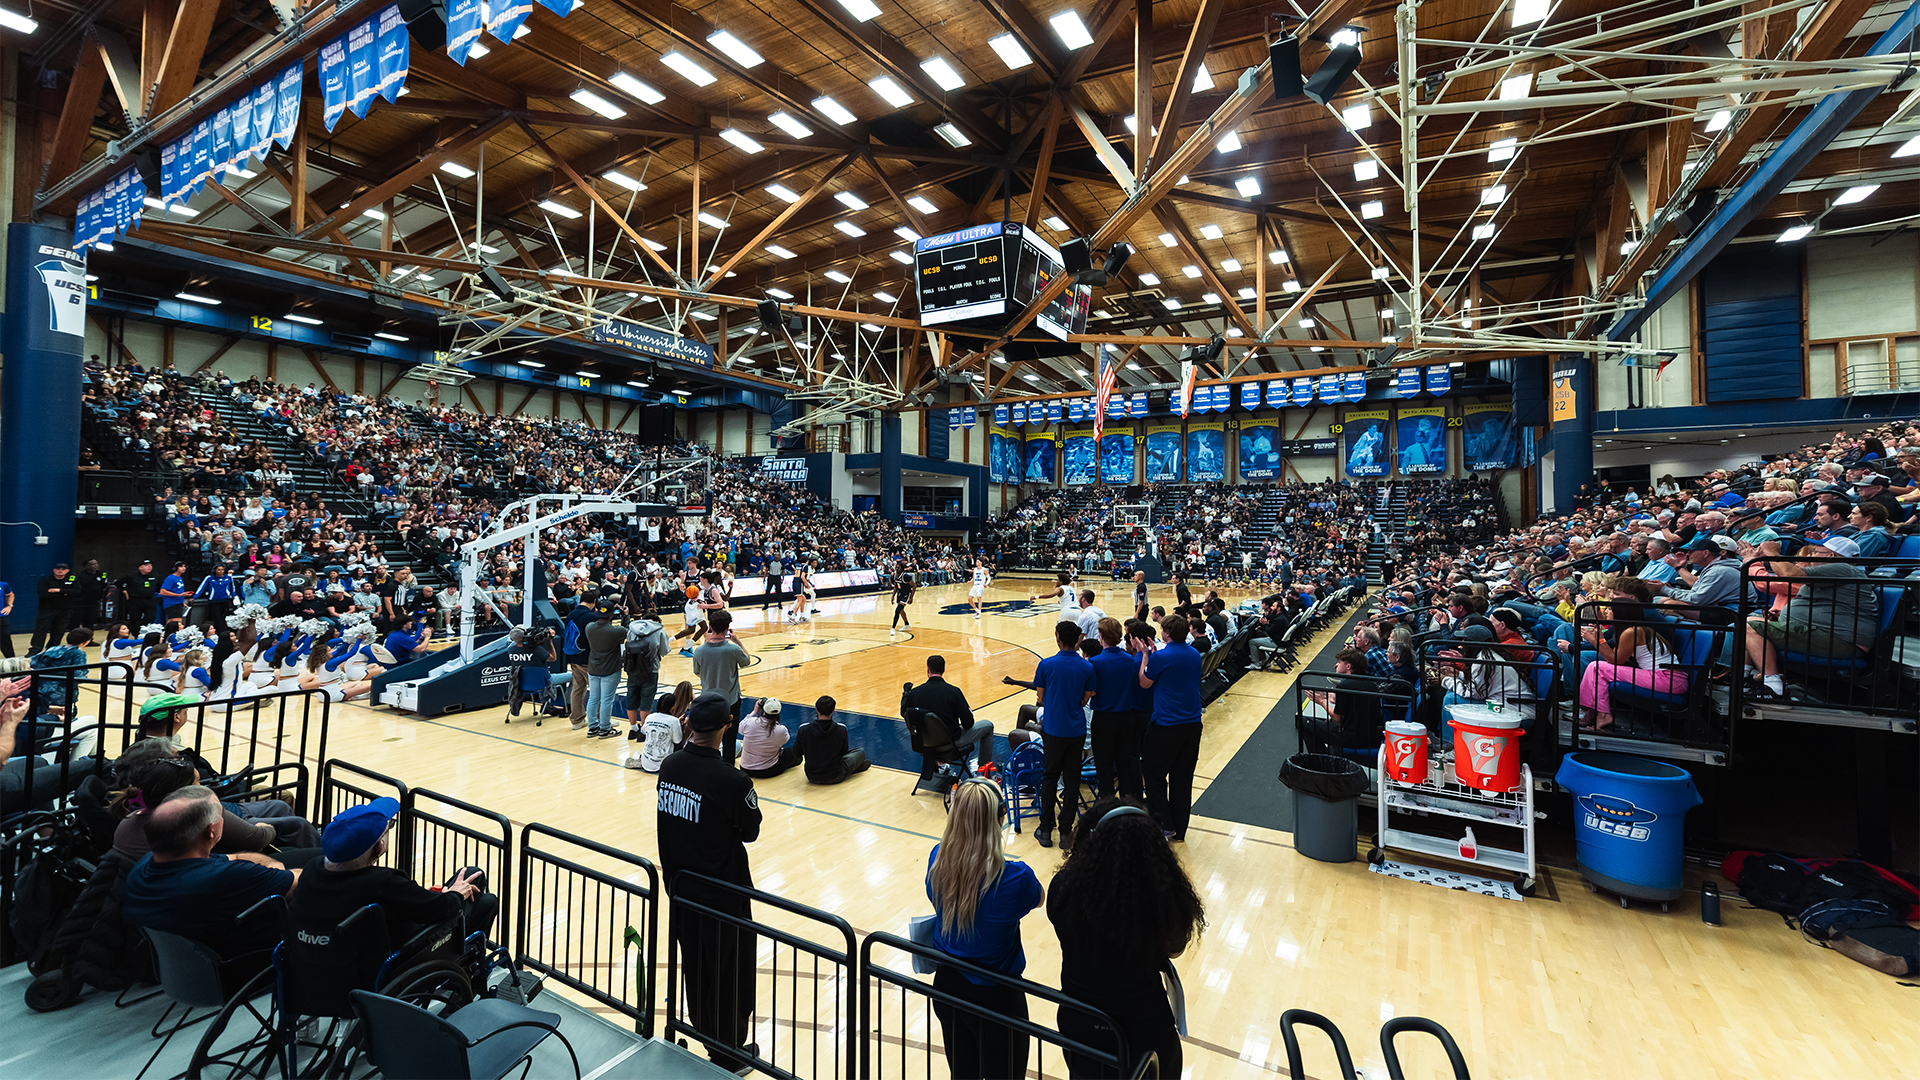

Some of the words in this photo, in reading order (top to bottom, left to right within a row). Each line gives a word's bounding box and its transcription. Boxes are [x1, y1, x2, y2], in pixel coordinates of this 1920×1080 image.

[495, 5, 519, 27] 1992
[924, 234, 955, 249] Michelob
[962, 226, 994, 240] ULTRA
[923, 266, 941, 275] UCSB
[69, 294, 80, 305] 6
[251, 315, 272, 331] 12
[602, 319, 618, 335] The
[620, 324, 676, 353] University
[676, 339, 708, 358] Center
[579, 377, 590, 388] 14
[677, 396, 687, 405] 15
[1555, 401, 1566, 411] 22
[1226, 420, 1238, 429] 18
[1447, 417, 1463, 427] 20
[1330, 424, 1343, 434] 19
[1055, 440, 1064, 448] 16
[1135, 435, 1145, 444] 17
[763, 459, 804, 470] SANTA
[550, 510, 579, 524] Schelde
[509, 653, 533, 662] FDNY
[481, 676, 498, 684] LEXUS
[1397, 740, 1412, 754] G
[1475, 739, 1494, 757] G
[660, 781, 702, 802] CHAMPION
[658, 788, 701, 823] SECURITY
[1584, 814, 1649, 840] UCSB
[298, 930, 330, 945] drive
[431, 932, 452, 951] drive
